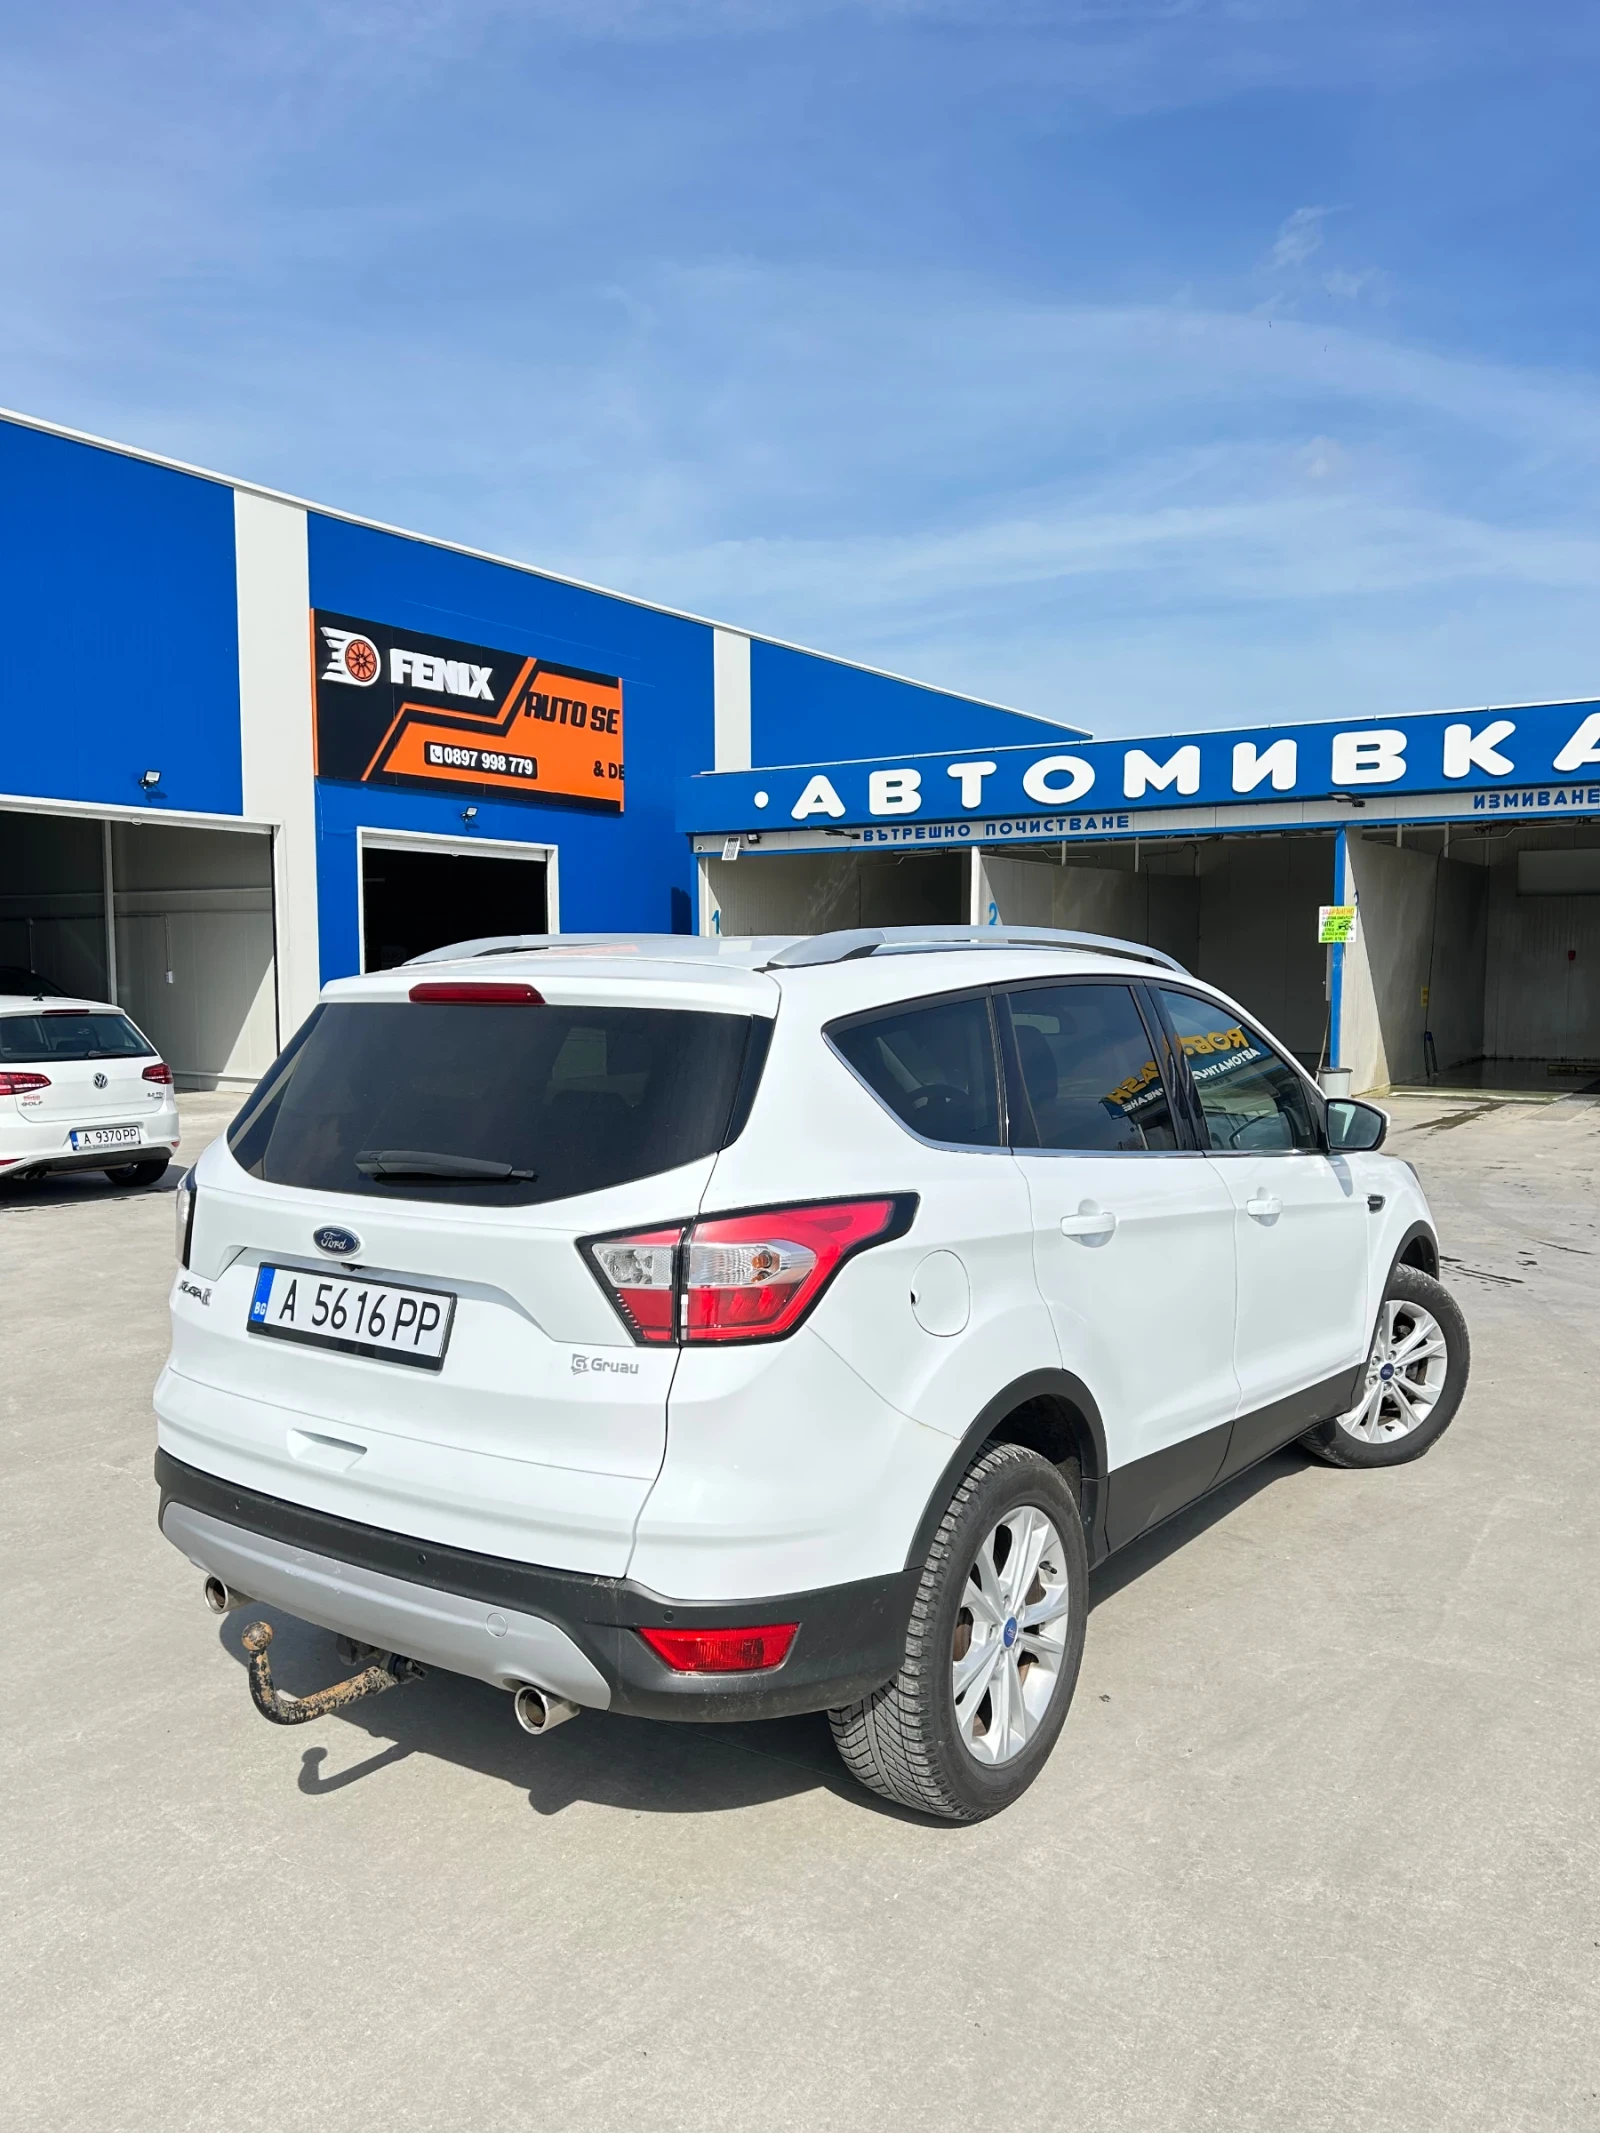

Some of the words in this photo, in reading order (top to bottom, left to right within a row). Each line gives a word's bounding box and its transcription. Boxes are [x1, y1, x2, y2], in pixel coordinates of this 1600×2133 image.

[389, 648, 495, 700] FENIX
[524, 691, 588, 728] AUTO
[443, 747, 478, 767] 0897
[481, 753, 506, 771] 998
[508, 757, 533, 775] 779
[593, 760, 605, 778] &
[790, 712, 1600, 820] АВТОМИВКА
[1473, 788, 1600, 810] ИЗМИВАНЕ
[863, 824, 971, 842] ВЪТРЕШНО
[985, 815, 1129, 836] ПОЧИСТВАНЕ
[711, 909, 720, 934] 1
[321, 1231, 348, 1251] Ford
[254, 1301, 266, 1316] BG
[279, 1279, 298, 1322] A
[591, 1357, 639, 1374] Gruau
